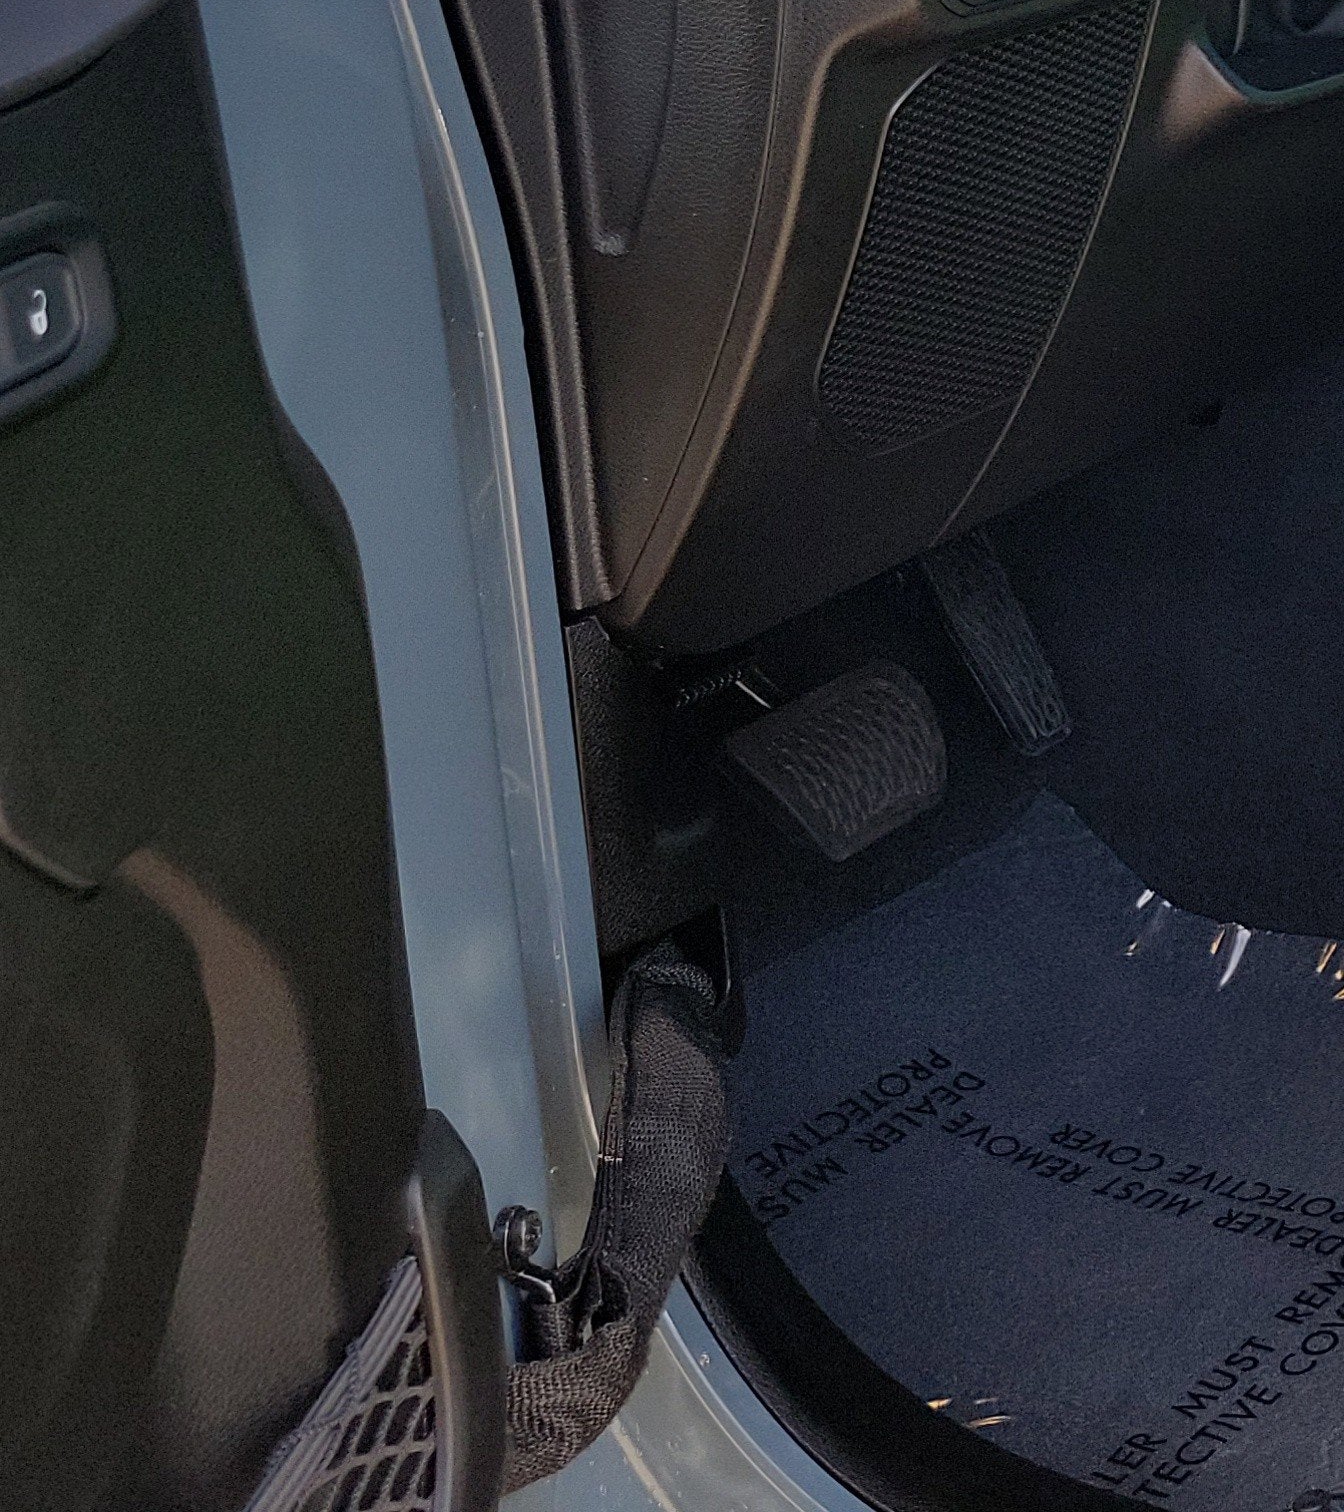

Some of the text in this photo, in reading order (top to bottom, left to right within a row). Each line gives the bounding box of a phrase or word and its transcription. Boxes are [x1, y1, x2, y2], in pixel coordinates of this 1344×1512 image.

[744, 1048, 952, 1178] PROTECTIVE
[856, 1071, 987, 1154] DEALER
[941, 1112, 1093, 1185] REMOVE
[1049, 1122, 1165, 1172] COVER
[1093, 1176, 1205, 1220] MUST
[1171, 1335, 1275, 1420] MUST
